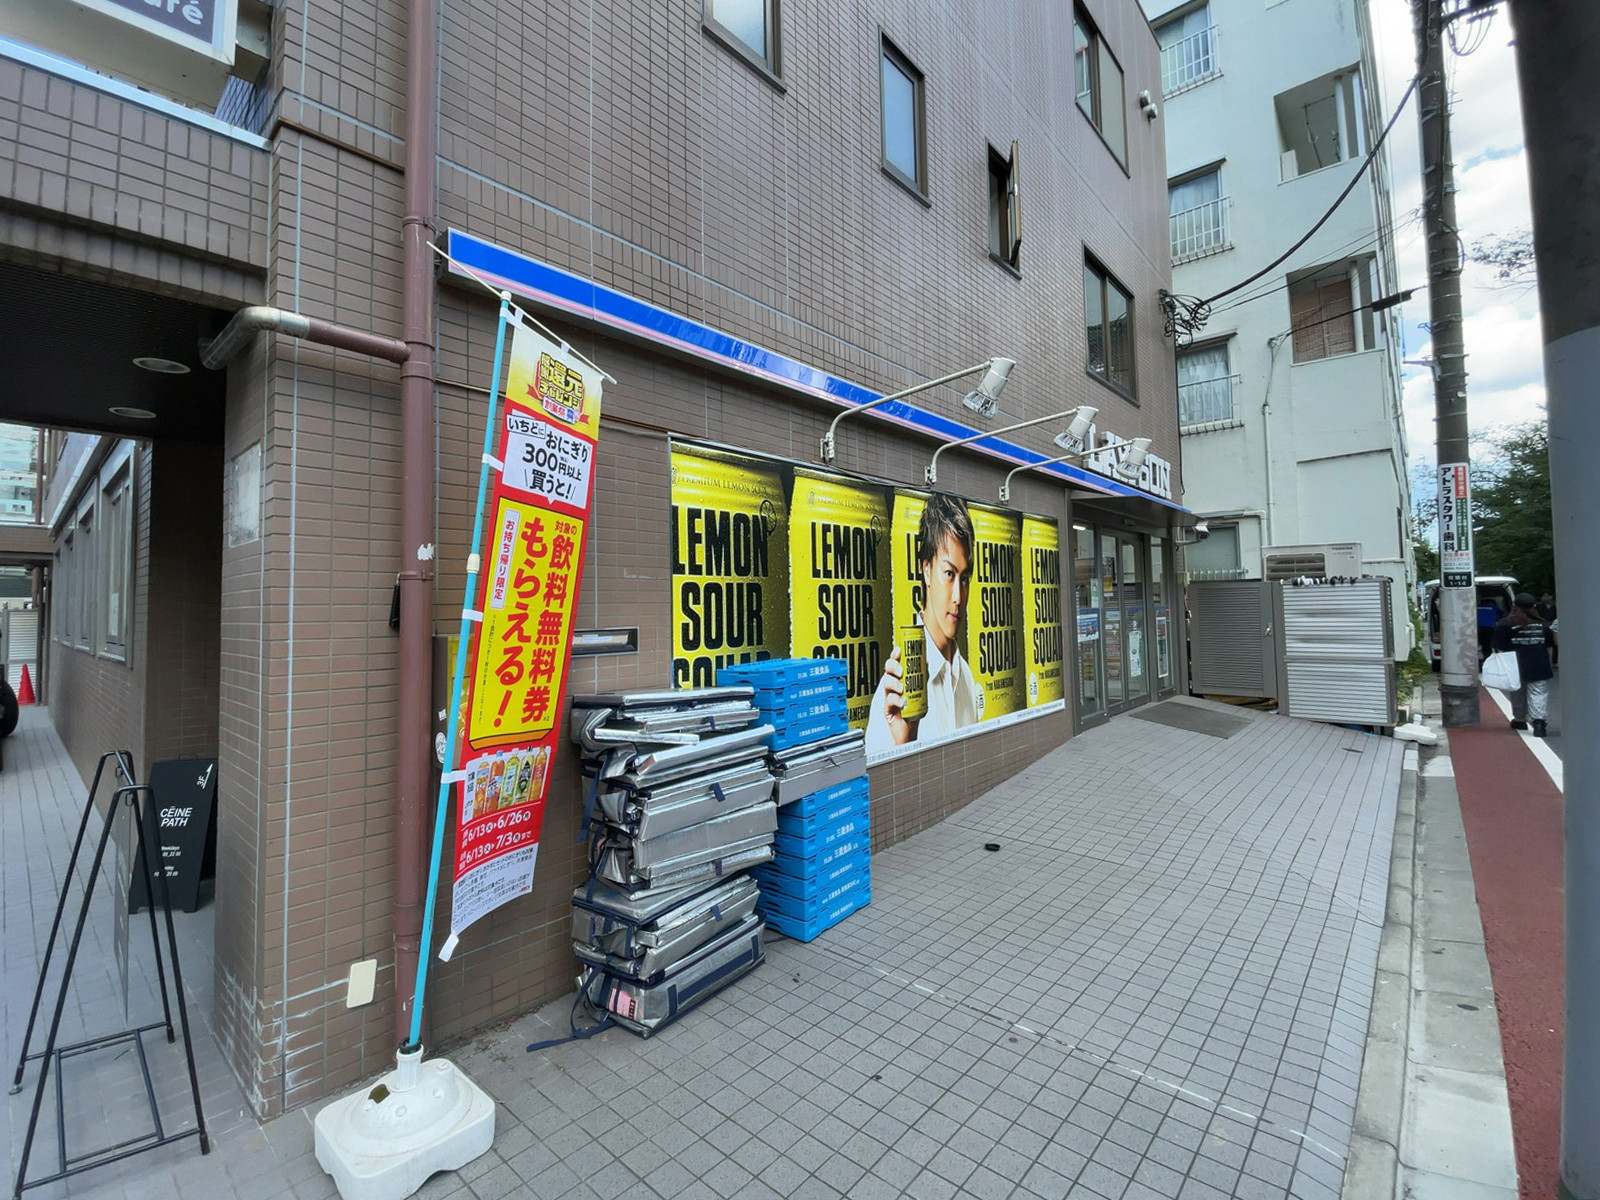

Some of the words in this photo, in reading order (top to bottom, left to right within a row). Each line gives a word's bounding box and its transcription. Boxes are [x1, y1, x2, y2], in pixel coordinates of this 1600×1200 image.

[672, 505, 769, 578] LEMON
[811, 522, 877, 581] LEMON
[976, 541, 1014, 584] LEMON
[521, 535, 575, 724] 飲料無料券
[681, 581, 764, 652] SOUR
[818, 583, 874, 641] SOUR
[981, 587, 1013, 628] SOUR
[904, 640, 923, 657] LEMON
[906, 657, 922, 674] SOUR
[979, 630, 1017, 677] SQUAD
[905, 674, 924, 693] SQUAD
[160, 817, 189, 828] PATH
